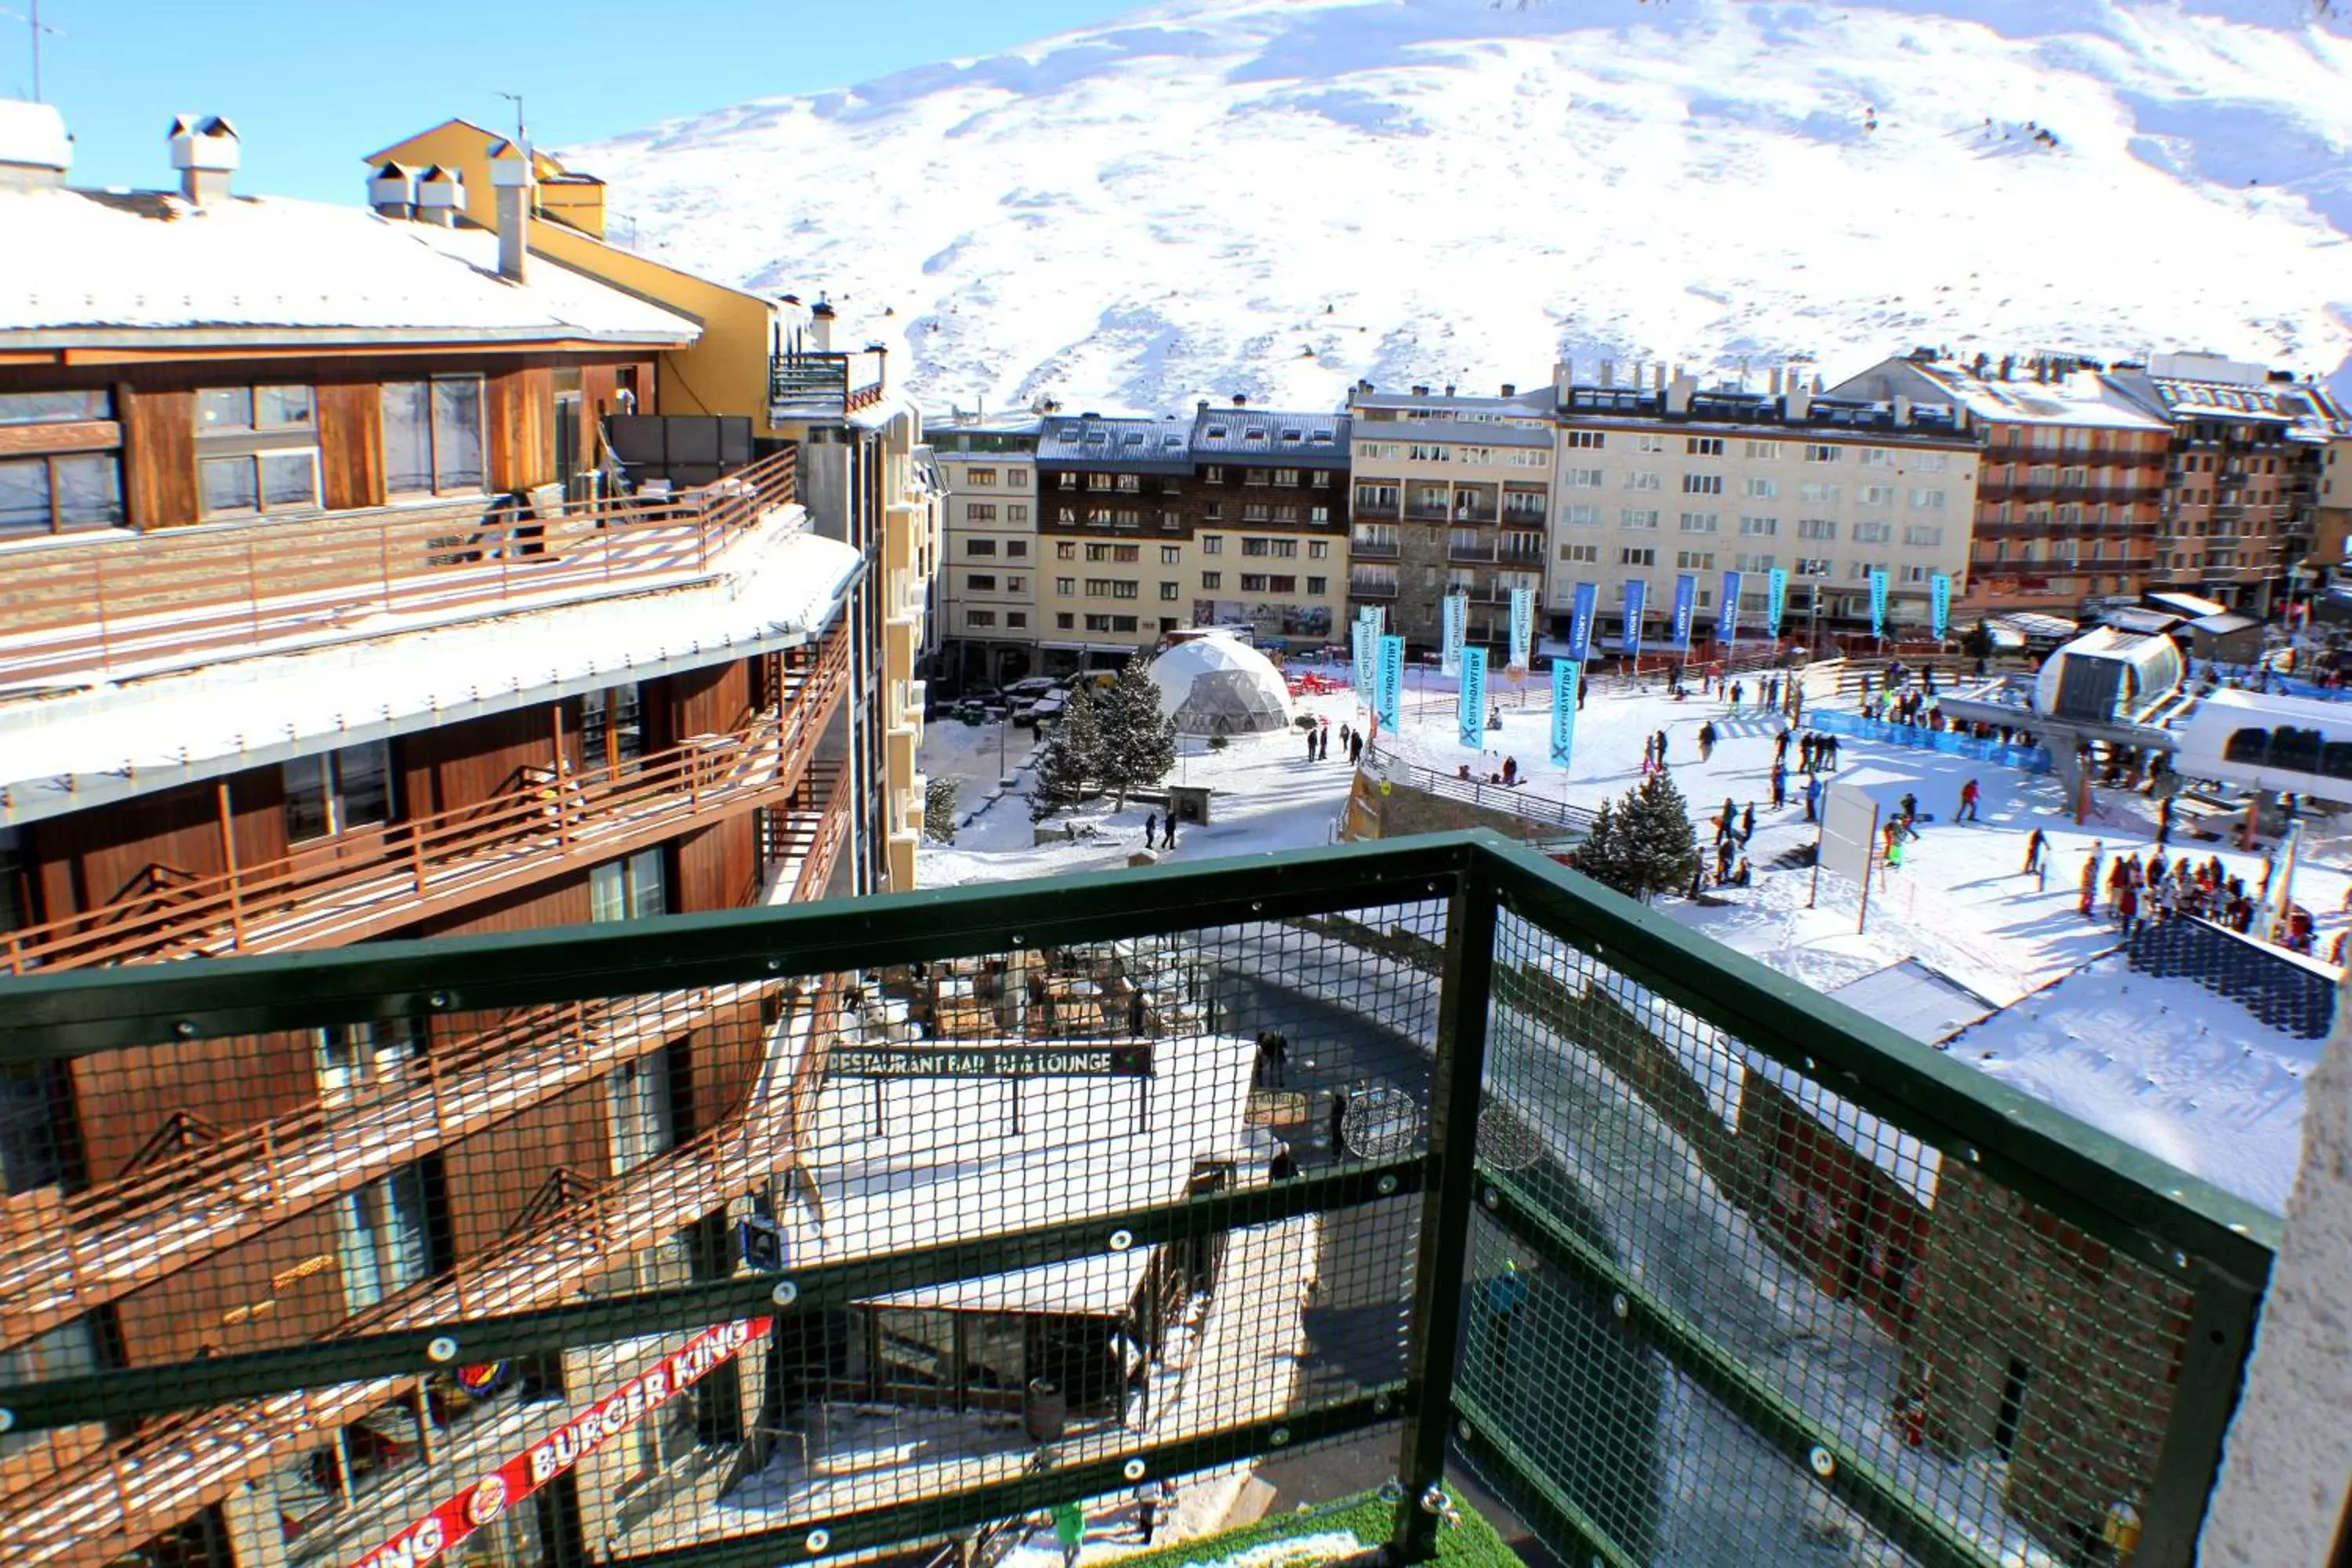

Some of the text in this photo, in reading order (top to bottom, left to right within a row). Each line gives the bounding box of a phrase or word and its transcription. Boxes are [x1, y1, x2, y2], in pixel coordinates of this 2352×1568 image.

[1039, 1052, 1112, 1073] LOUNGE
[532, 1318, 749, 1483] BURGER KING
